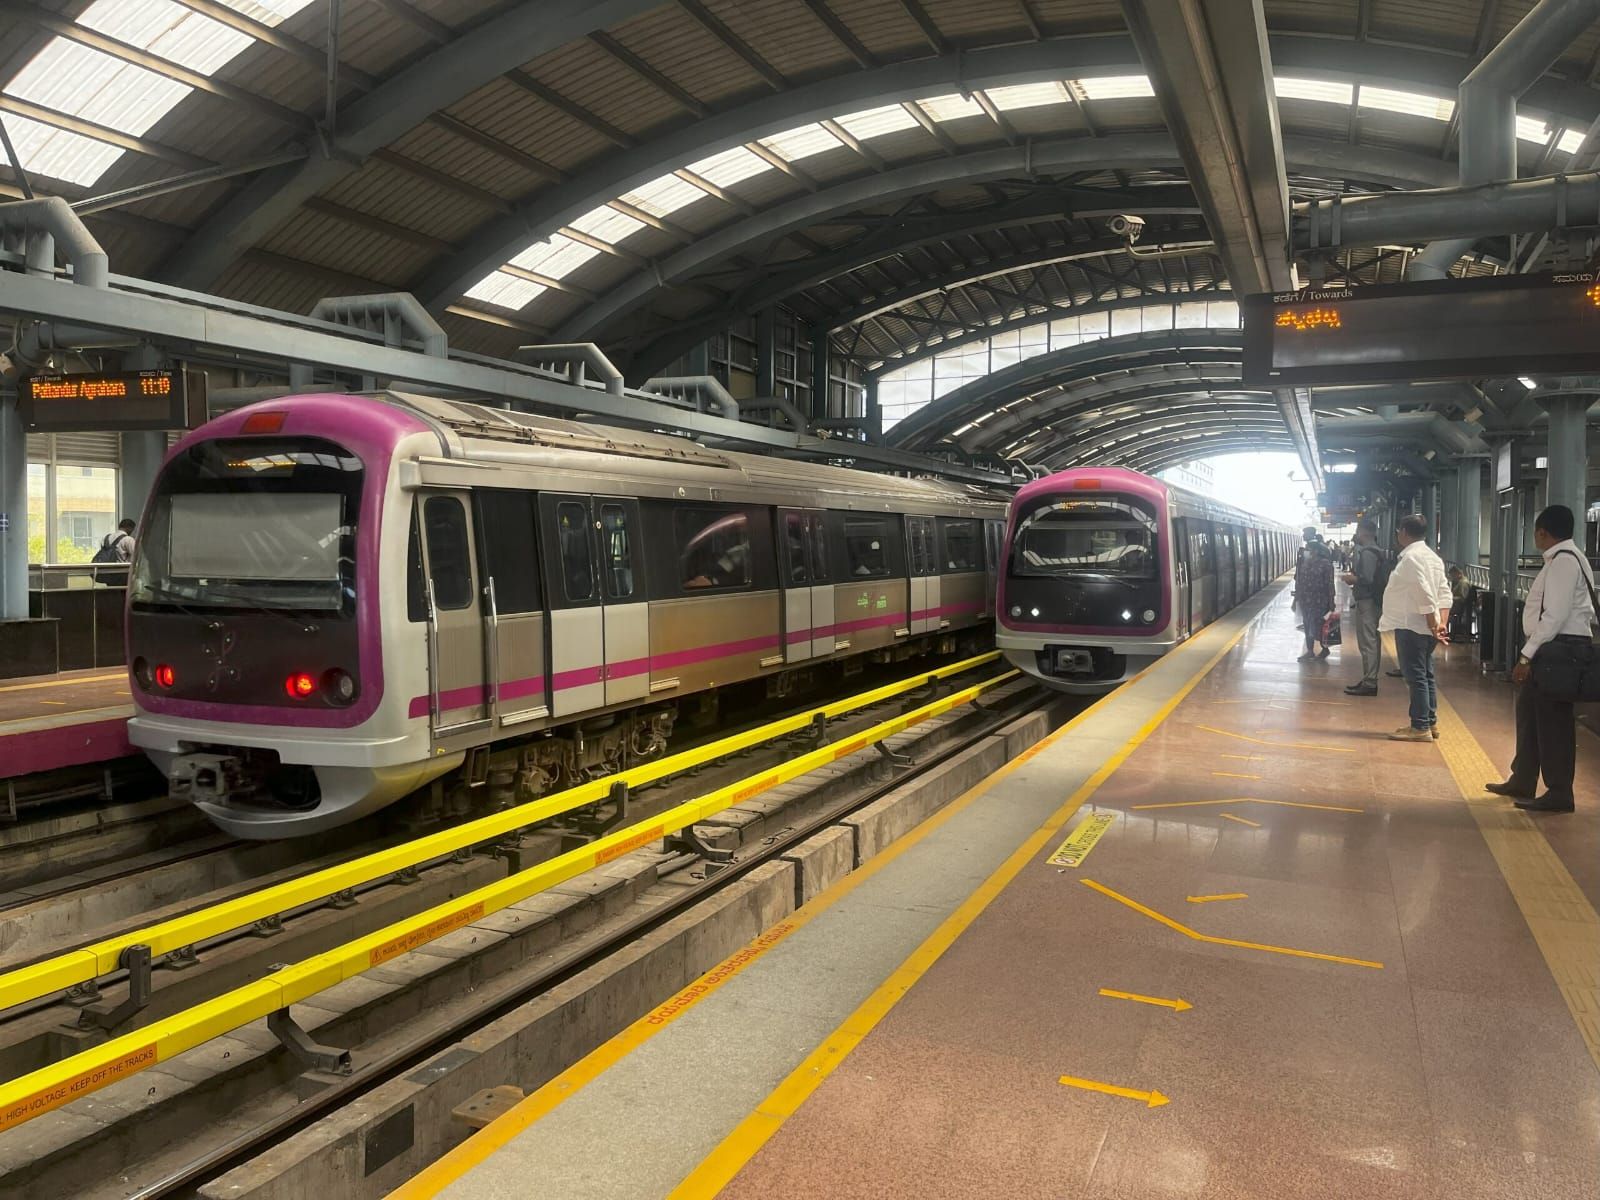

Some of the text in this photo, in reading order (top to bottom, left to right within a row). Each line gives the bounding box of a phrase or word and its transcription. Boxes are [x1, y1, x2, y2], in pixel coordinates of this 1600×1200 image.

[1308, 289, 1353, 300] Towards
[6, 1104, 28, 1121] HIGH
[70, 1077, 91, 1093] KEEP
[92, 1070, 107, 1083] OFF
[109, 1062, 123, 1075] THE
[124, 1049, 154, 1069] TRACKS
